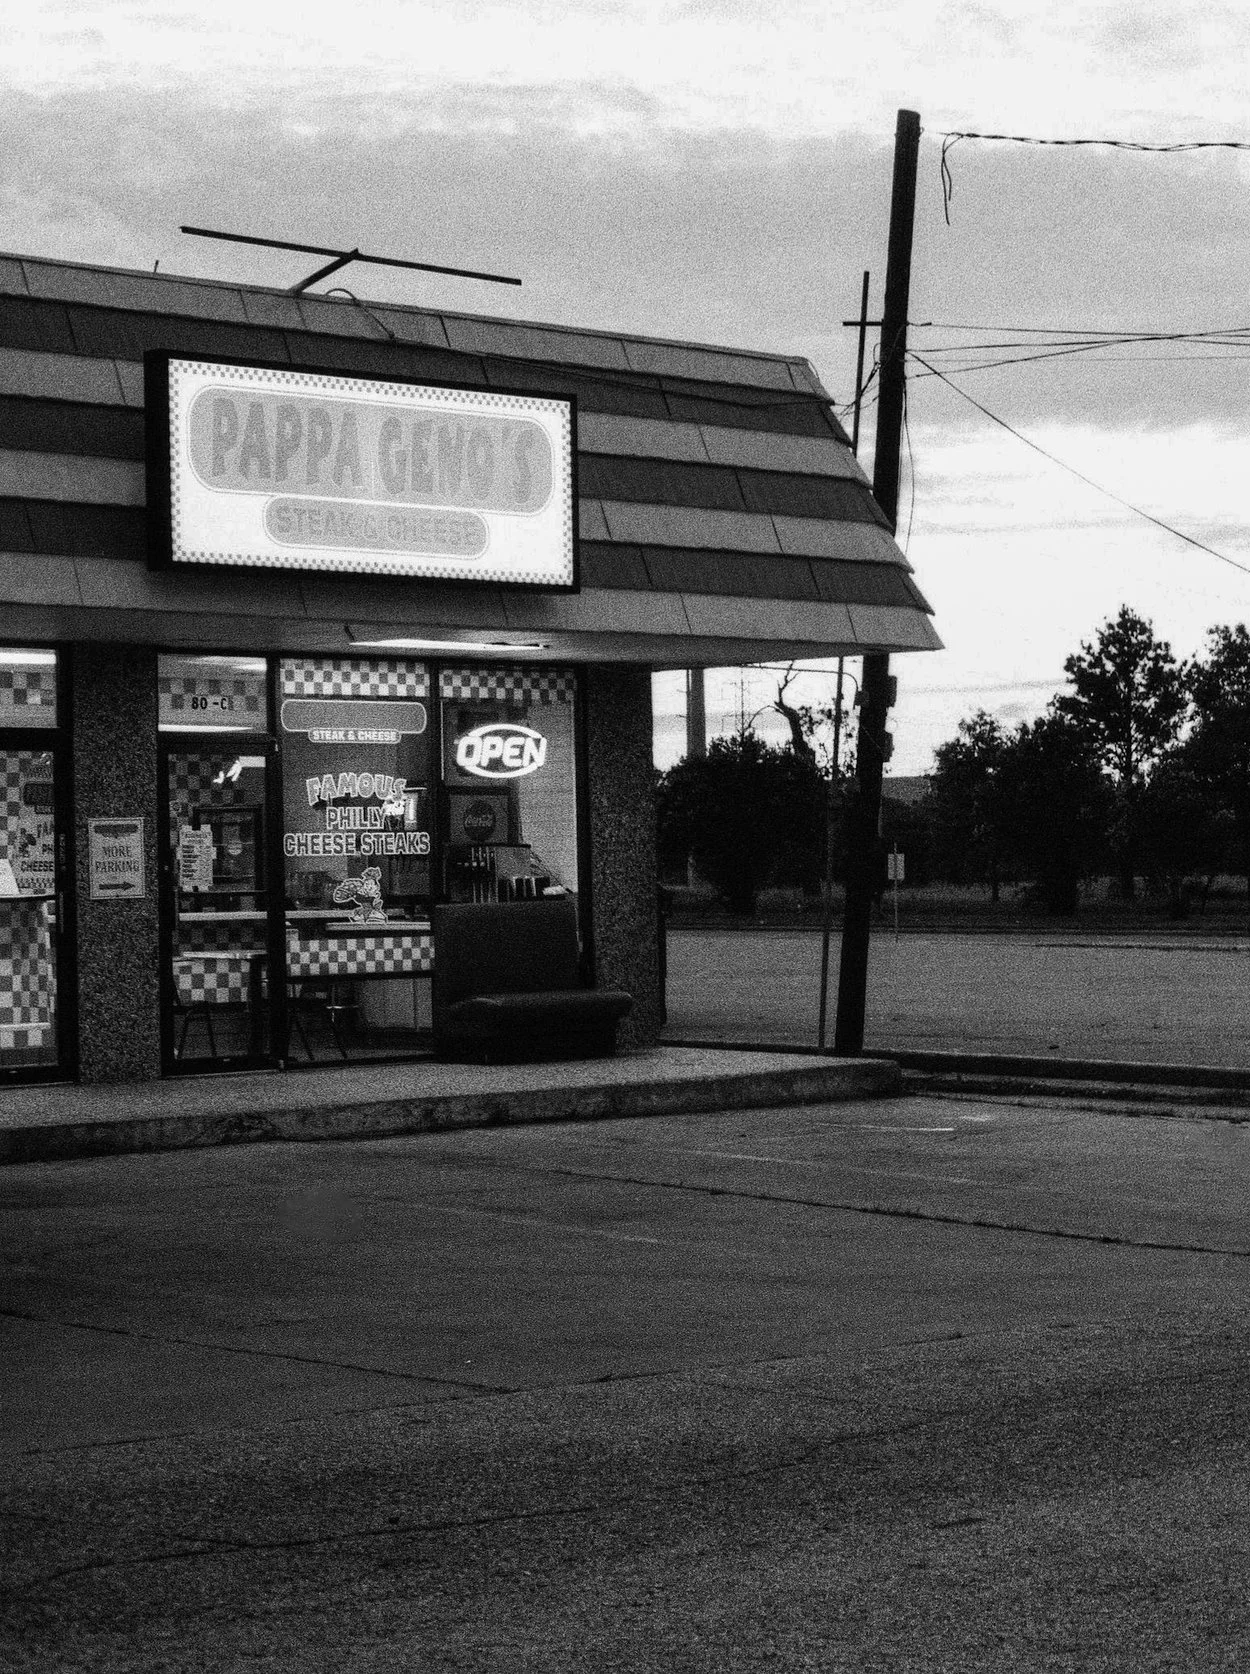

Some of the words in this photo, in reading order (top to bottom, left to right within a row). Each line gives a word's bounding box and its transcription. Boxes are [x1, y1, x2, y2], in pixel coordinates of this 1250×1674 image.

[211, 396, 361, 487] PAPPA
[377, 416, 535, 504] GENO'S
[276, 505, 356, 537] STEAK
[387, 514, 477, 546] CHEESE
[313, 730, 345, 741] STEAK
[347, 730, 356, 741] &
[358, 731, 397, 741] CHEESE
[455, 735, 548, 769] OPEN
[306, 772, 407, 806] FAMOUS
[326, 807, 386, 830] PHILLY
[101, 845, 133, 858] MORE
[283, 833, 356, 856] CHEESE
[361, 832, 431, 855] STEAKS
[20, 860, 54, 872] CHEESE
[94, 860, 140, 873] PARKING
